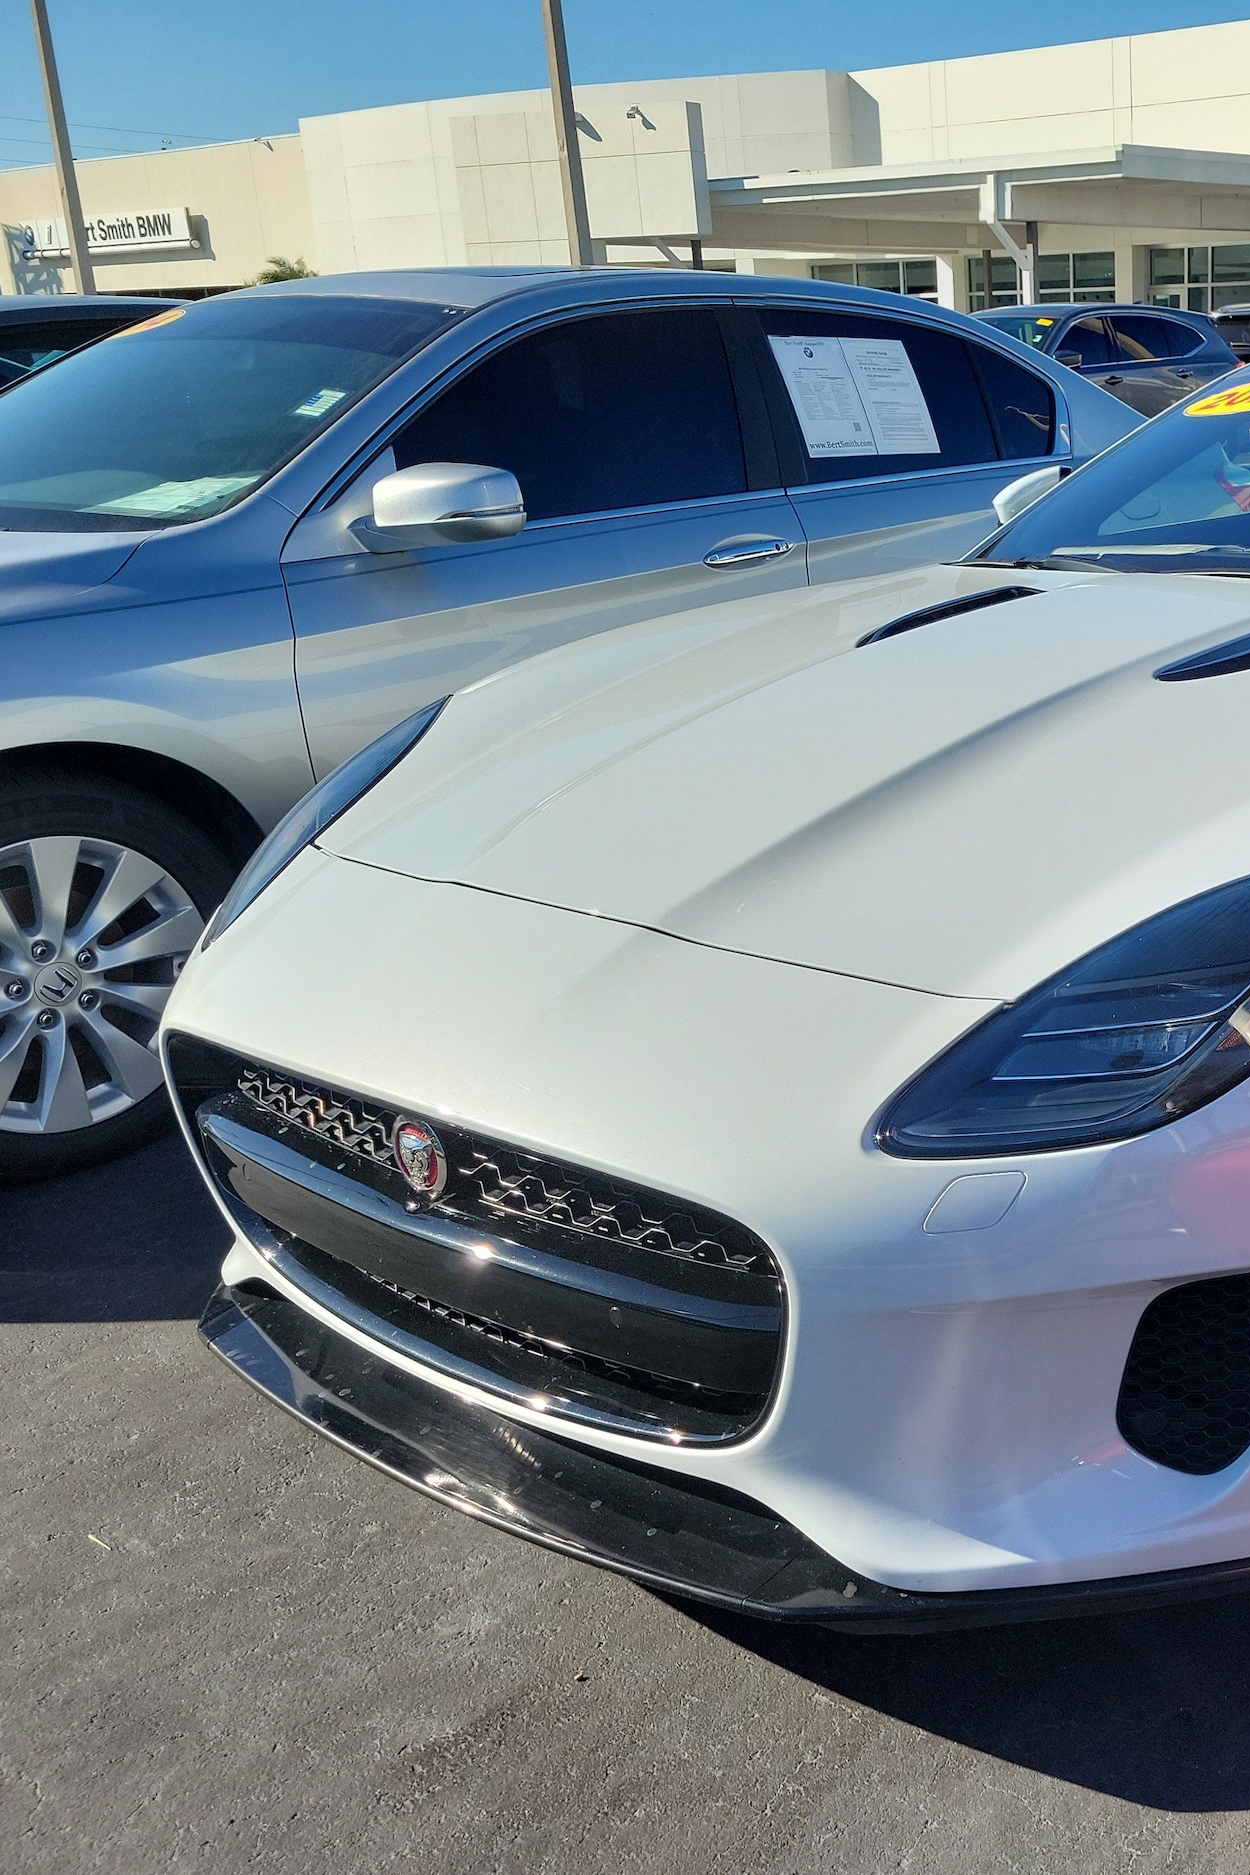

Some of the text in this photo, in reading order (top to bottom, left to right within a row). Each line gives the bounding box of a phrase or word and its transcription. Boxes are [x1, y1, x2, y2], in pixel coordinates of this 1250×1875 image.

[97, 217, 136, 241] Smith
[136, 213, 172, 238] BMW
[809, 440, 873, 449] www.BertSmith.com
